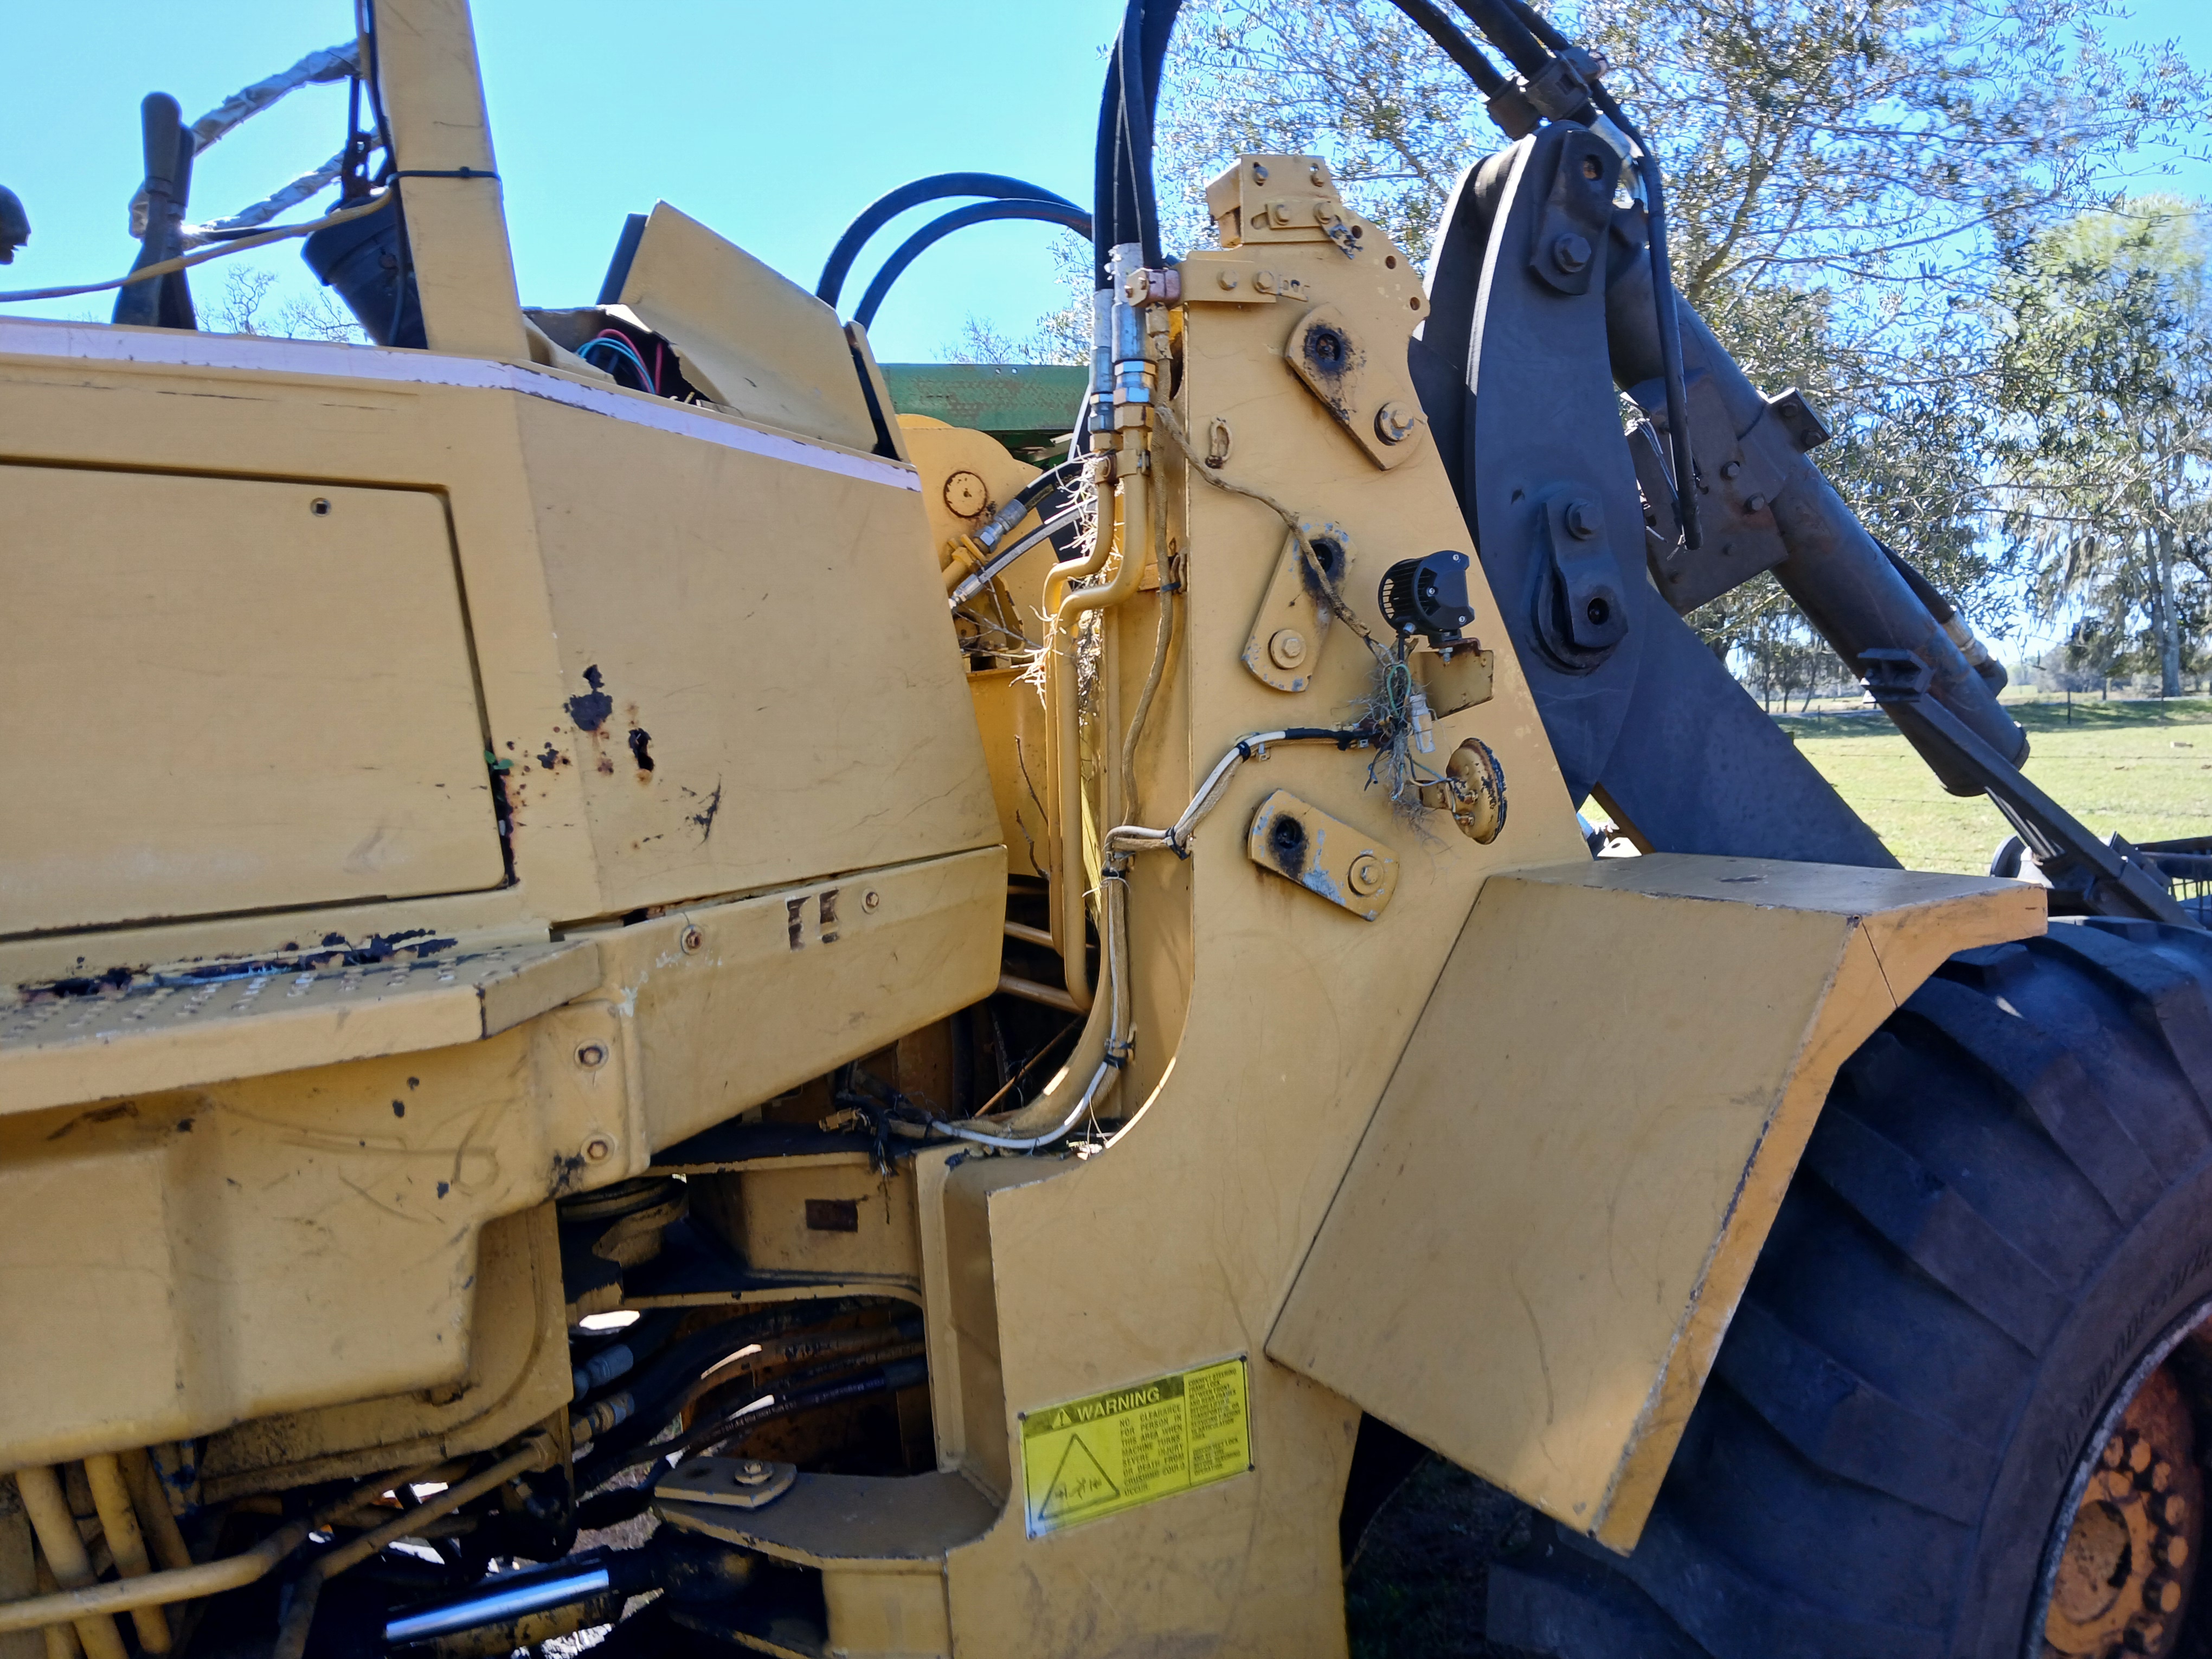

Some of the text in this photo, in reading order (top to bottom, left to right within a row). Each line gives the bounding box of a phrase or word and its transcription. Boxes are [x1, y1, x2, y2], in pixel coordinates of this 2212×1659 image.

[1188, 1369, 1237, 1387] CONNECT STEERING
[1077, 1388, 1159, 1421] WARNING
[1120, 1405, 1181, 1428] NO CLEARANCE
[1121, 1414, 1182, 1437] FOR PERSON IN
[1122, 1424, 1182, 1448] THIS AREA WHEN
[1122, 1443, 1153, 1456] MACHINE
[1123, 1443, 1184, 1468] SEVERE INJURY
[1123, 1453, 1185, 1477] OR DEATH FROM
[1124, 1462, 1185, 1486] CRUSHING COULD
